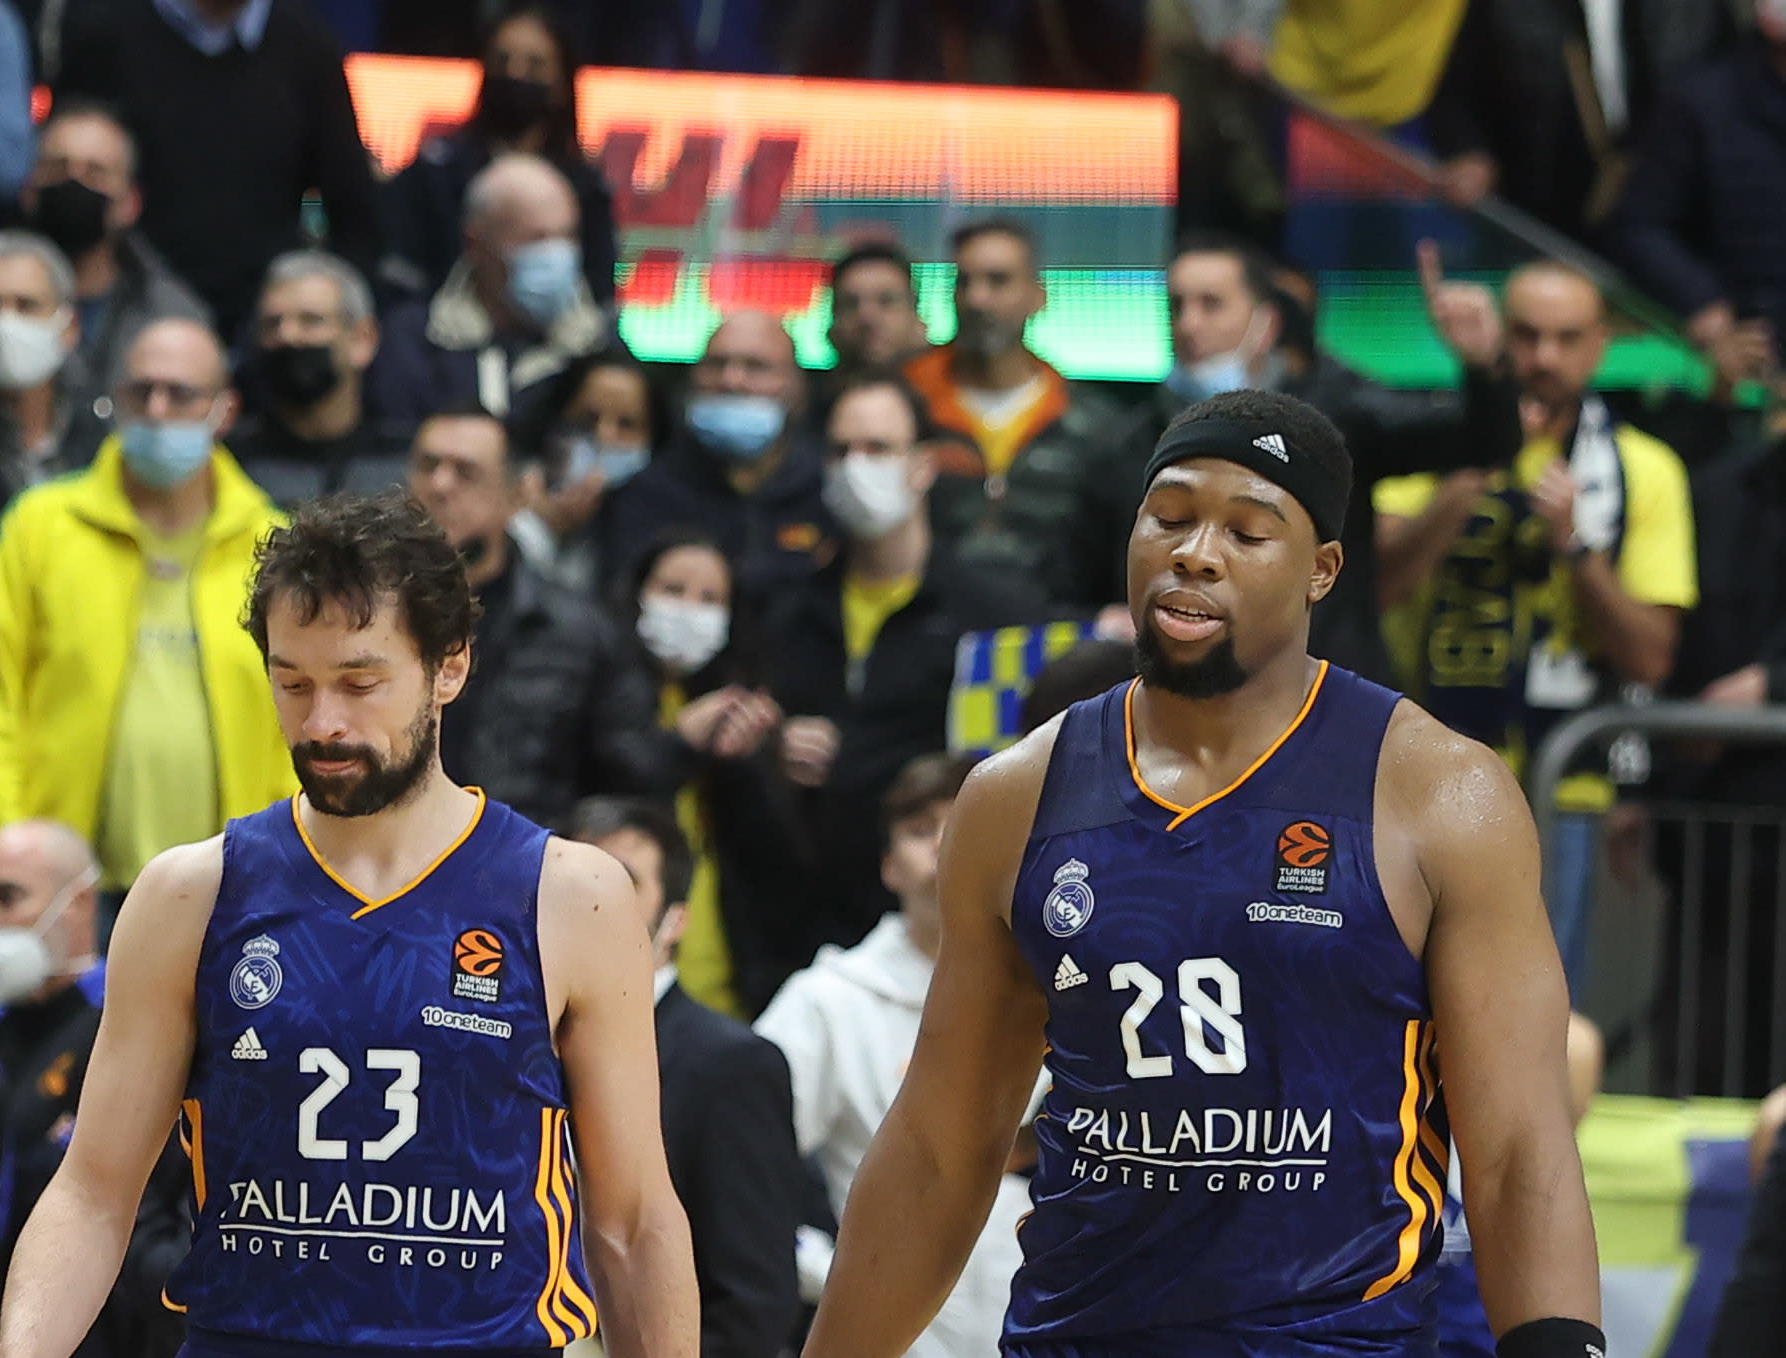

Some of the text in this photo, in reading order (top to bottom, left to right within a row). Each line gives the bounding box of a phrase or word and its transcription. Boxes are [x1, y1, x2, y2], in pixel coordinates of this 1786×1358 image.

[1278, 875, 1324, 885] AIRLINES
[1279, 867, 1325, 878] TURKISH
[455, 982, 498, 995] AIRLINES
[456, 973, 499, 988] TURKISH
[1109, 957, 1247, 1079] 28
[231, 1048, 268, 1061] adidas
[298, 1048, 421, 1161] 23
[1067, 1107, 1332, 1155] PALLADIUM
[1071, 1158, 1326, 1192] HOTEL GROUP
[221, 1234, 503, 1270] HOTEL GROUP
